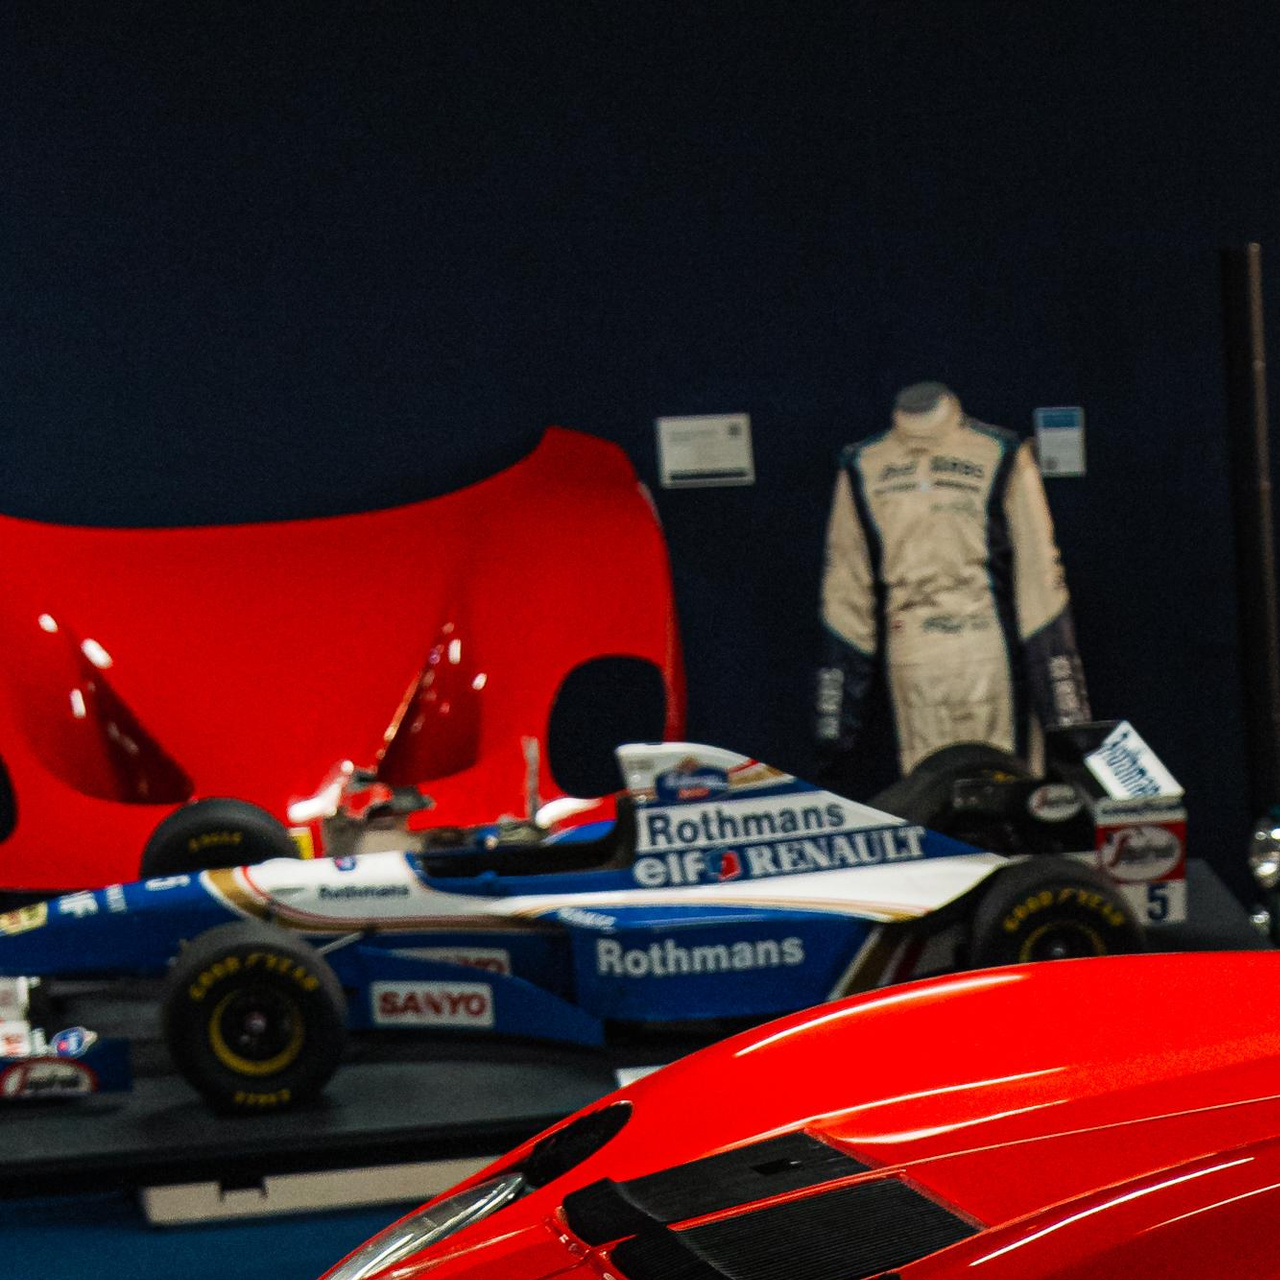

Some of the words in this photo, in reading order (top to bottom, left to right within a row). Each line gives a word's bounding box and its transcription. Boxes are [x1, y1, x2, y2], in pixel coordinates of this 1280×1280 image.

[647, 802, 846, 847] Rothmans
[742, 826, 926, 878] RENAULT
[1146, 884, 1168, 921] 5
[596, 936, 806, 978] Rothmans
[378, 990, 487, 1018] SANYO
